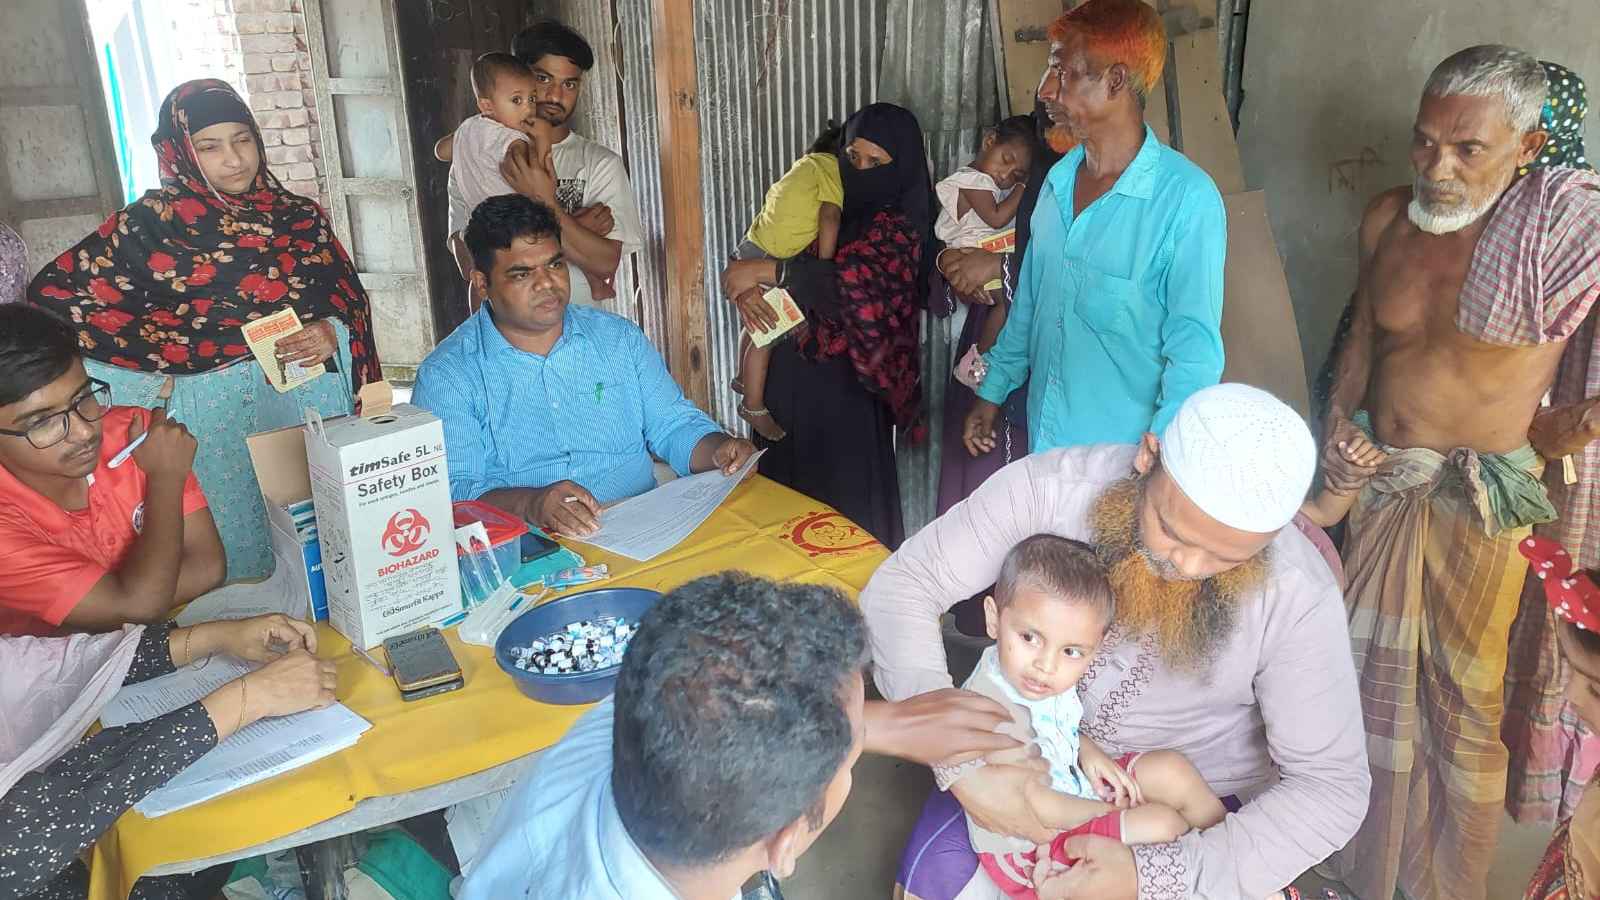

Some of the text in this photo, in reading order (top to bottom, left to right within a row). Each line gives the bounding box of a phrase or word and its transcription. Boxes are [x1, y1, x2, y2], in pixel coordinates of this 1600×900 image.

[349, 451, 411, 477] timSafe
[415, 444, 431, 458] 5L
[357, 464, 438, 498] Safety Box
[377, 548, 440, 577] BIOHAZARD
